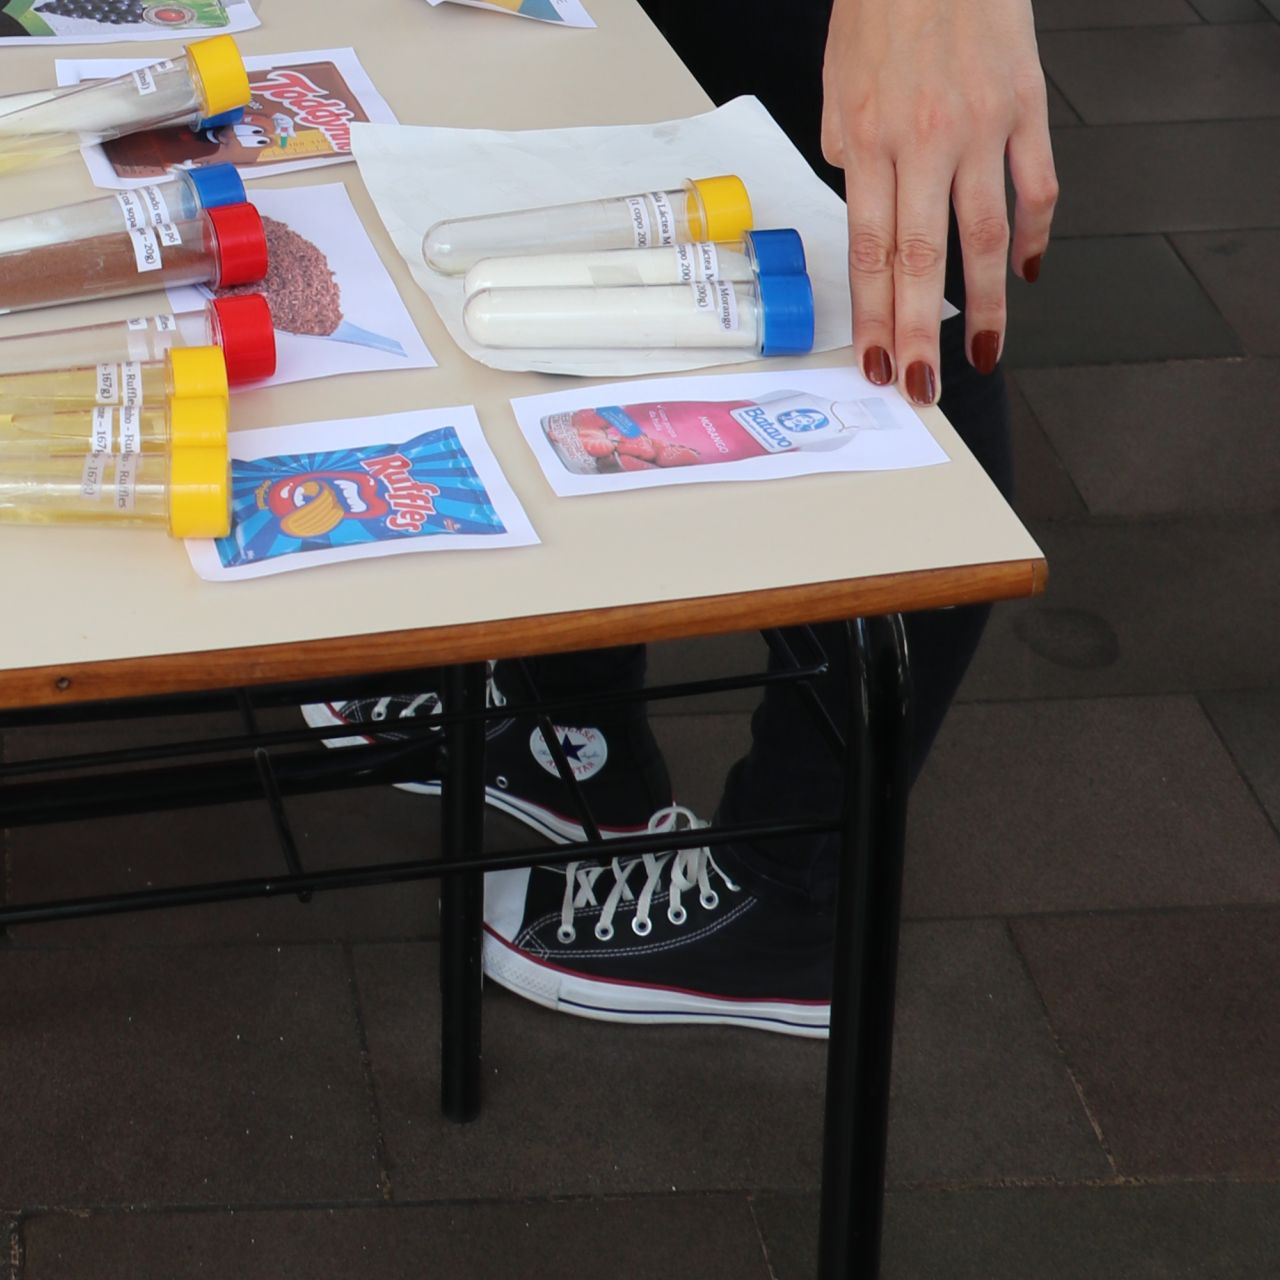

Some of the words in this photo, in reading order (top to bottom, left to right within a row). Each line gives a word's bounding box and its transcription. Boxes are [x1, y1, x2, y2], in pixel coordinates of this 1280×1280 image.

[633, 207, 644, 229] copo
[657, 203, 669, 234] Láctea
[144, 243, 156, 265] 20g)
[720, 288, 732, 330] Morango
[100, 372, 112, 400] 167g)
[743, 406, 793, 449] Batavo
[360, 453, 441, 533] Ruffles
